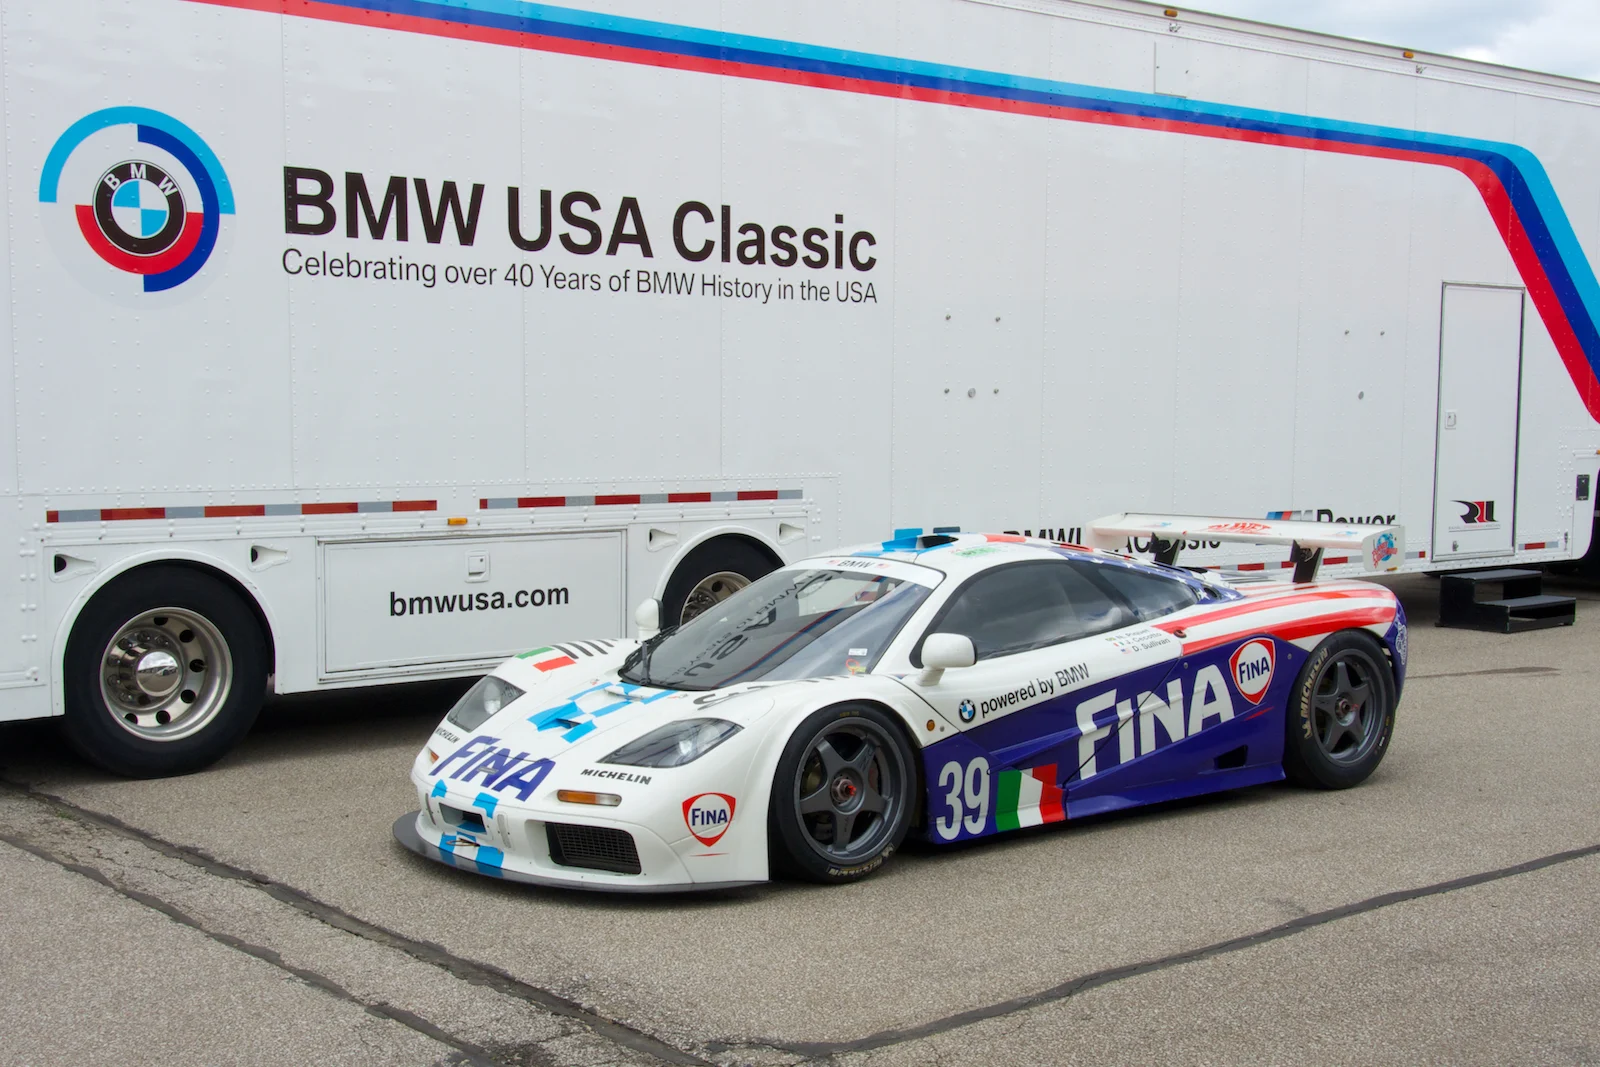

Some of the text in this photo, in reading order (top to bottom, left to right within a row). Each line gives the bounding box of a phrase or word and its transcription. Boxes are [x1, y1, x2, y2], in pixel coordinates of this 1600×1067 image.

[103, 163, 179, 197] BMW
[283, 165, 877, 272] BMW USA Classic
[282, 248, 878, 304] Celebrating over 40 Years of BMW History in the USA
[837, 559, 876, 569] BMW
[389, 587, 569, 617] bmwusa.com
[1141, 638, 1171, 650] Sullivan
[980, 680, 1036, 718] powered
[1036, 678, 1055, 695] by
[1055, 662, 1090, 687] BMW
[1238, 656, 1271, 684] FINA
[1300, 647, 1329, 718] MICHELIN
[1075, 664, 1236, 781] FINA
[428, 735, 556, 802] FINA
[580, 768, 653, 785] MICHELIN
[691, 807, 728, 827] FINA
[936, 756, 990, 840] 39
